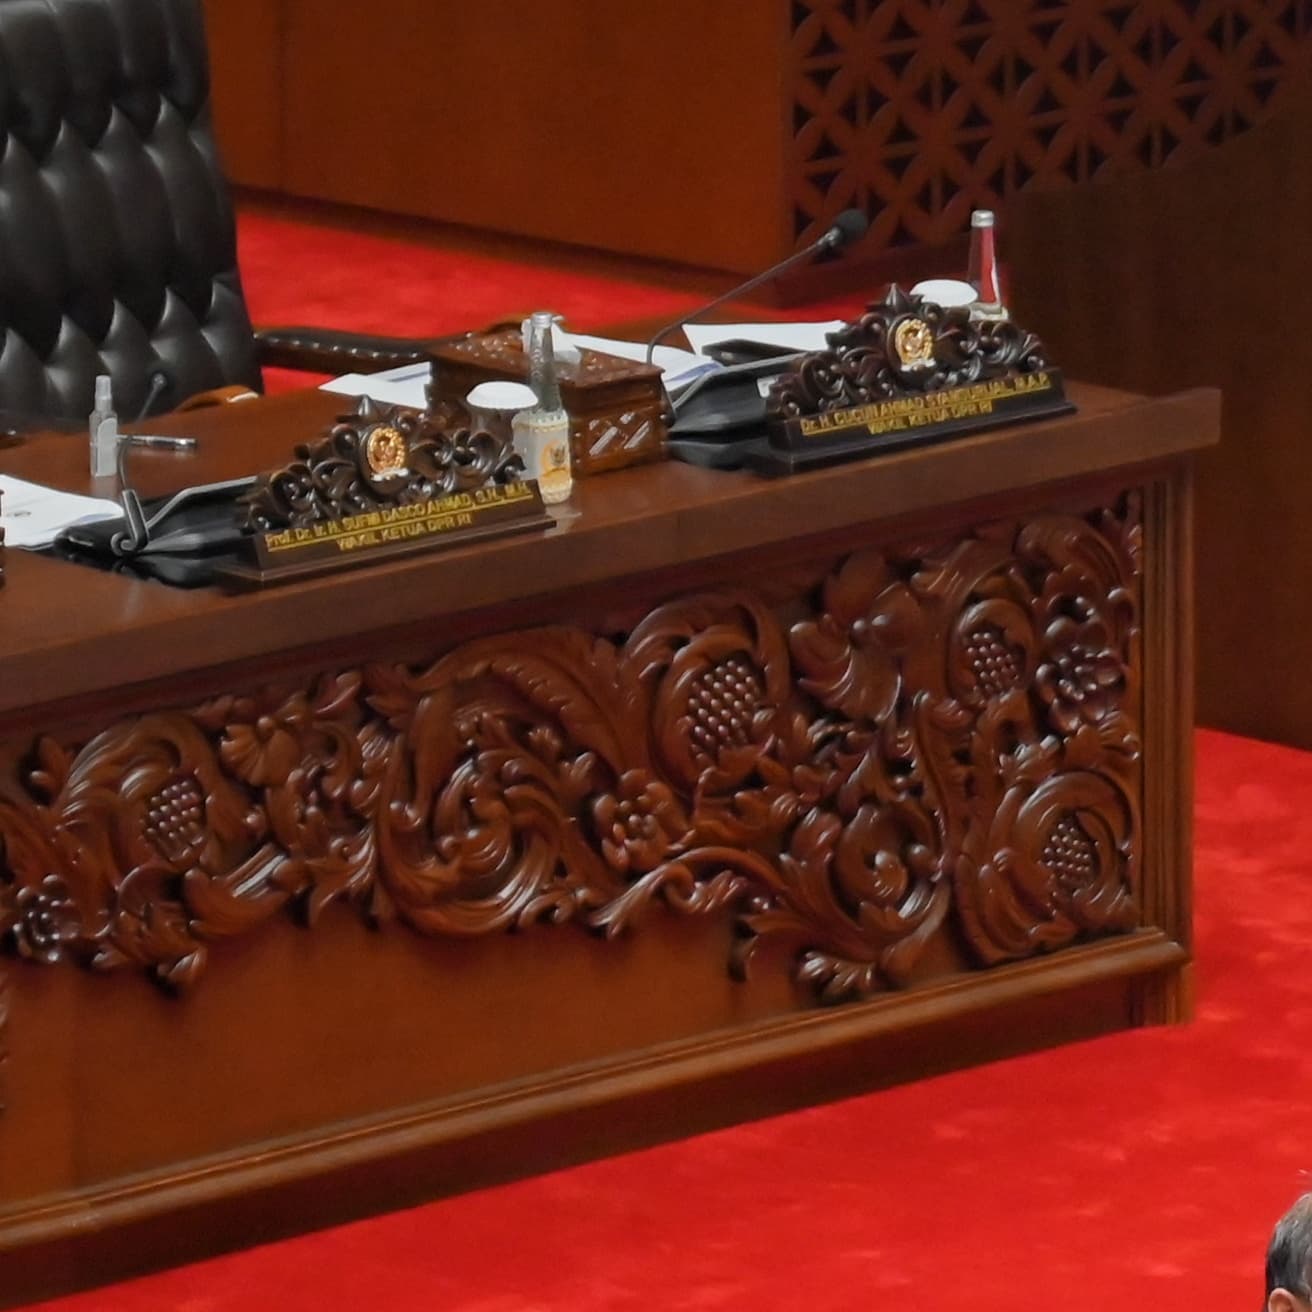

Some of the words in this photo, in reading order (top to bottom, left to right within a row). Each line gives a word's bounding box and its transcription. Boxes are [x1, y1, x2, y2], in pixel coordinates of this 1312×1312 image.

[328, 519, 341, 534] H.
[381, 503, 426, 523] DASCO
[427, 493, 475, 513] AHMAD,
[336, 532, 380, 552] WAKIL
[381, 522, 427, 542] KETUA
[427, 515, 456, 532] DPR
[457, 512, 473, 527] RI
